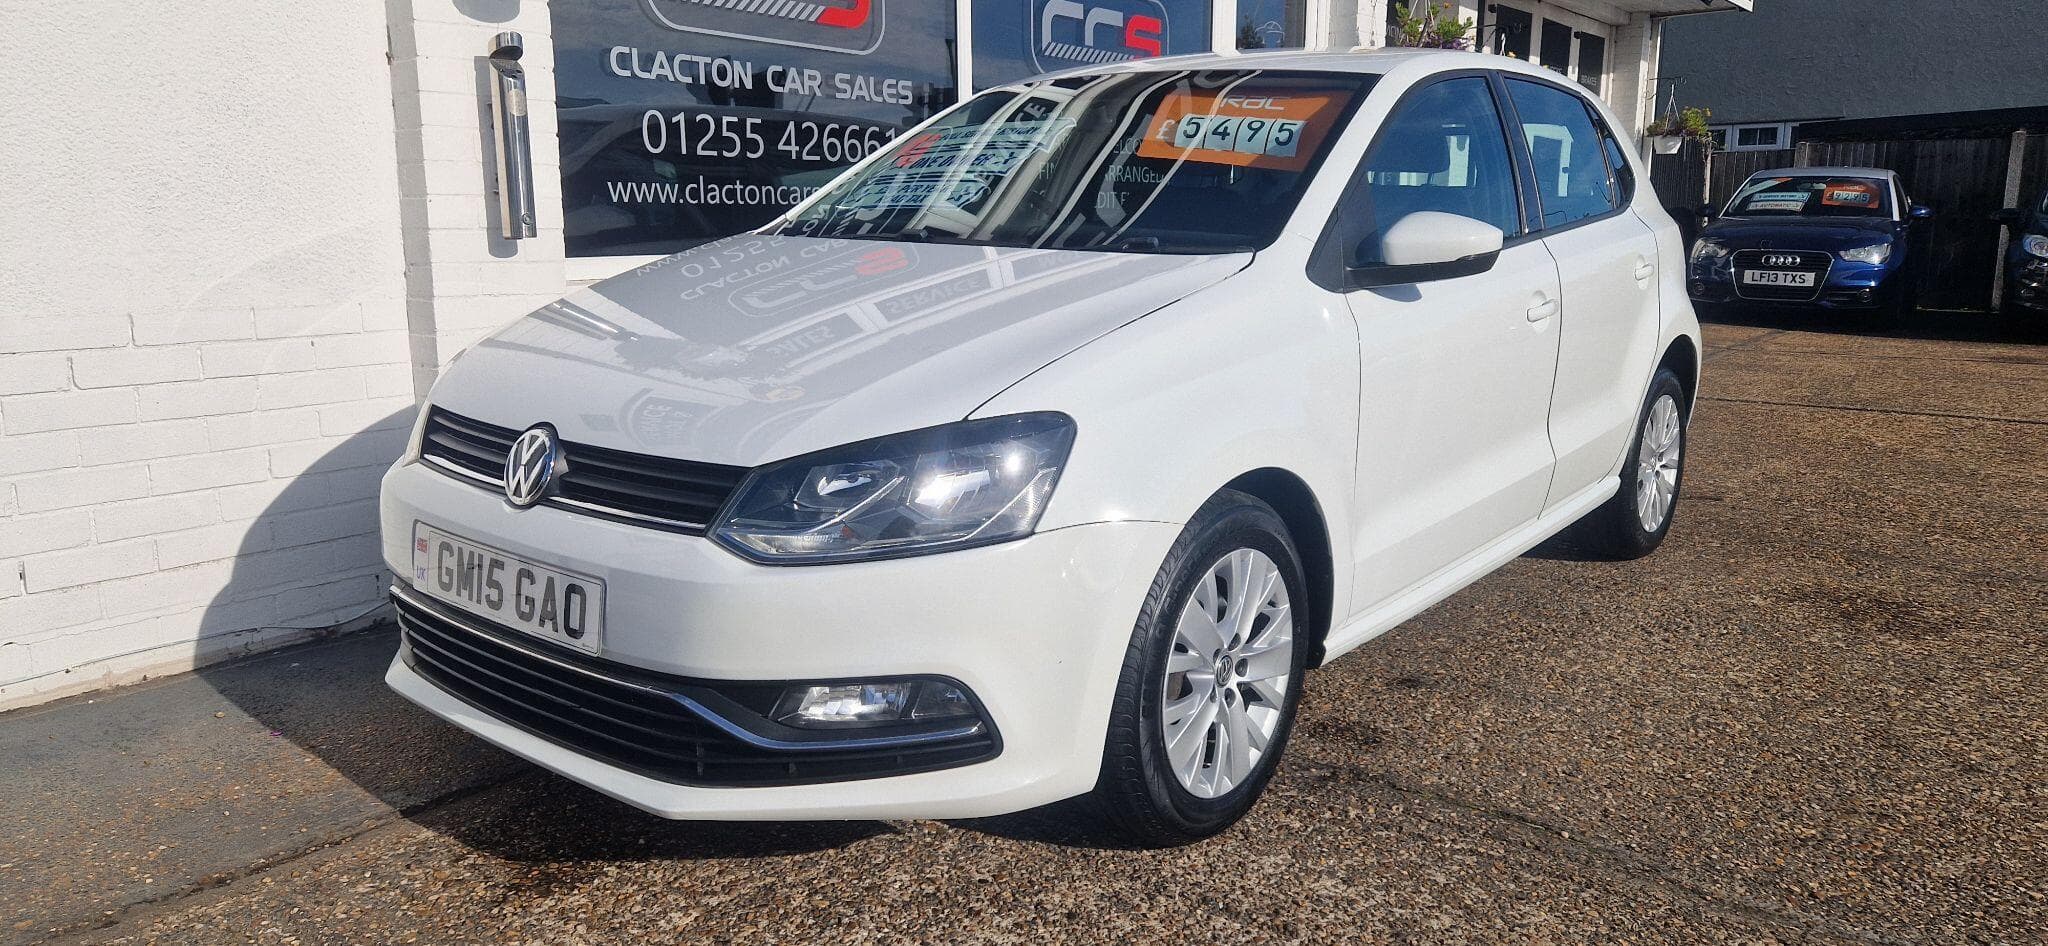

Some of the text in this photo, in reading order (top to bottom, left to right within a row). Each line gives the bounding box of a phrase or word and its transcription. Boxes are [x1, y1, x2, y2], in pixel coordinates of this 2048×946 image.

[609, 45, 914, 105] CLACTON CAR SALES
[642, 109, 765, 159] 01255
[1751, 271, 1806, 284] LF13 TXS
[415, 563, 428, 582] UK
[437, 540, 588, 640] GM15 GAO
